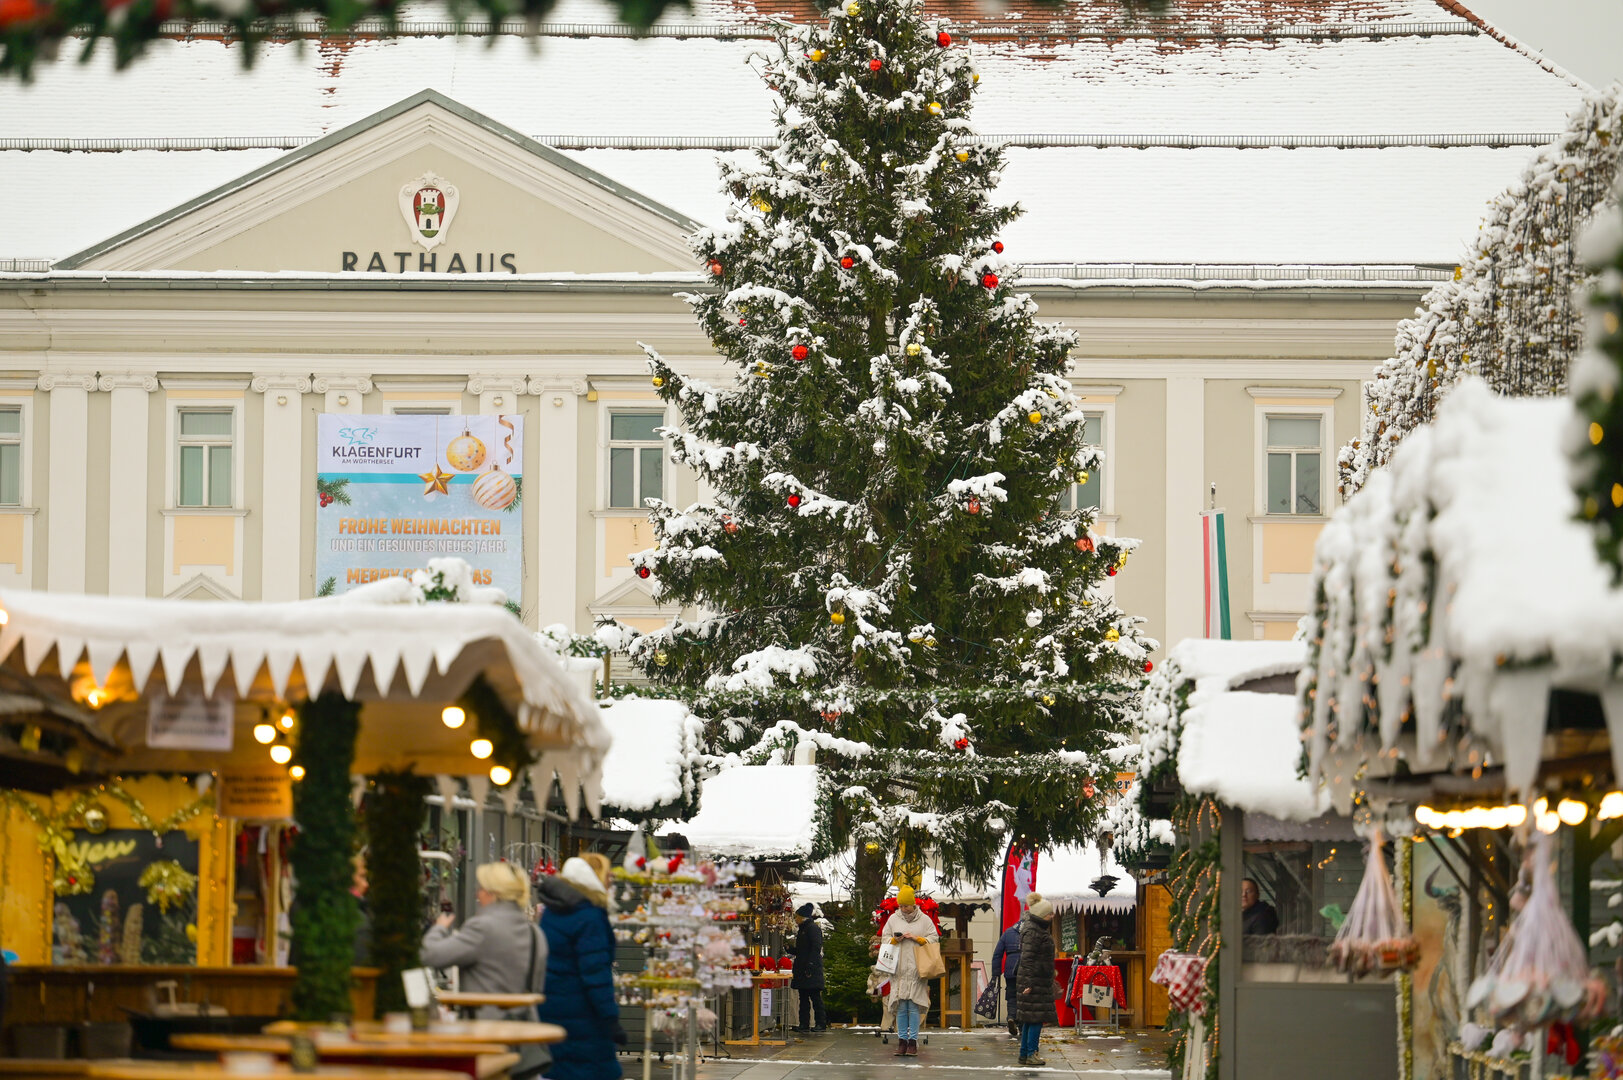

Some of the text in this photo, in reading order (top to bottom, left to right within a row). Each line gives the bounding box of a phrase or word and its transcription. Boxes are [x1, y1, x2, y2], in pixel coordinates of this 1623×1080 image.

[342, 251, 517, 275] RATHAUS
[332, 446, 422, 458] KLAGENFURT
[339, 518, 501, 535] FROHE WEIHNACHTEN
[331, 539, 507, 554] UND EIN GESUNDES NEUES JAHR!
